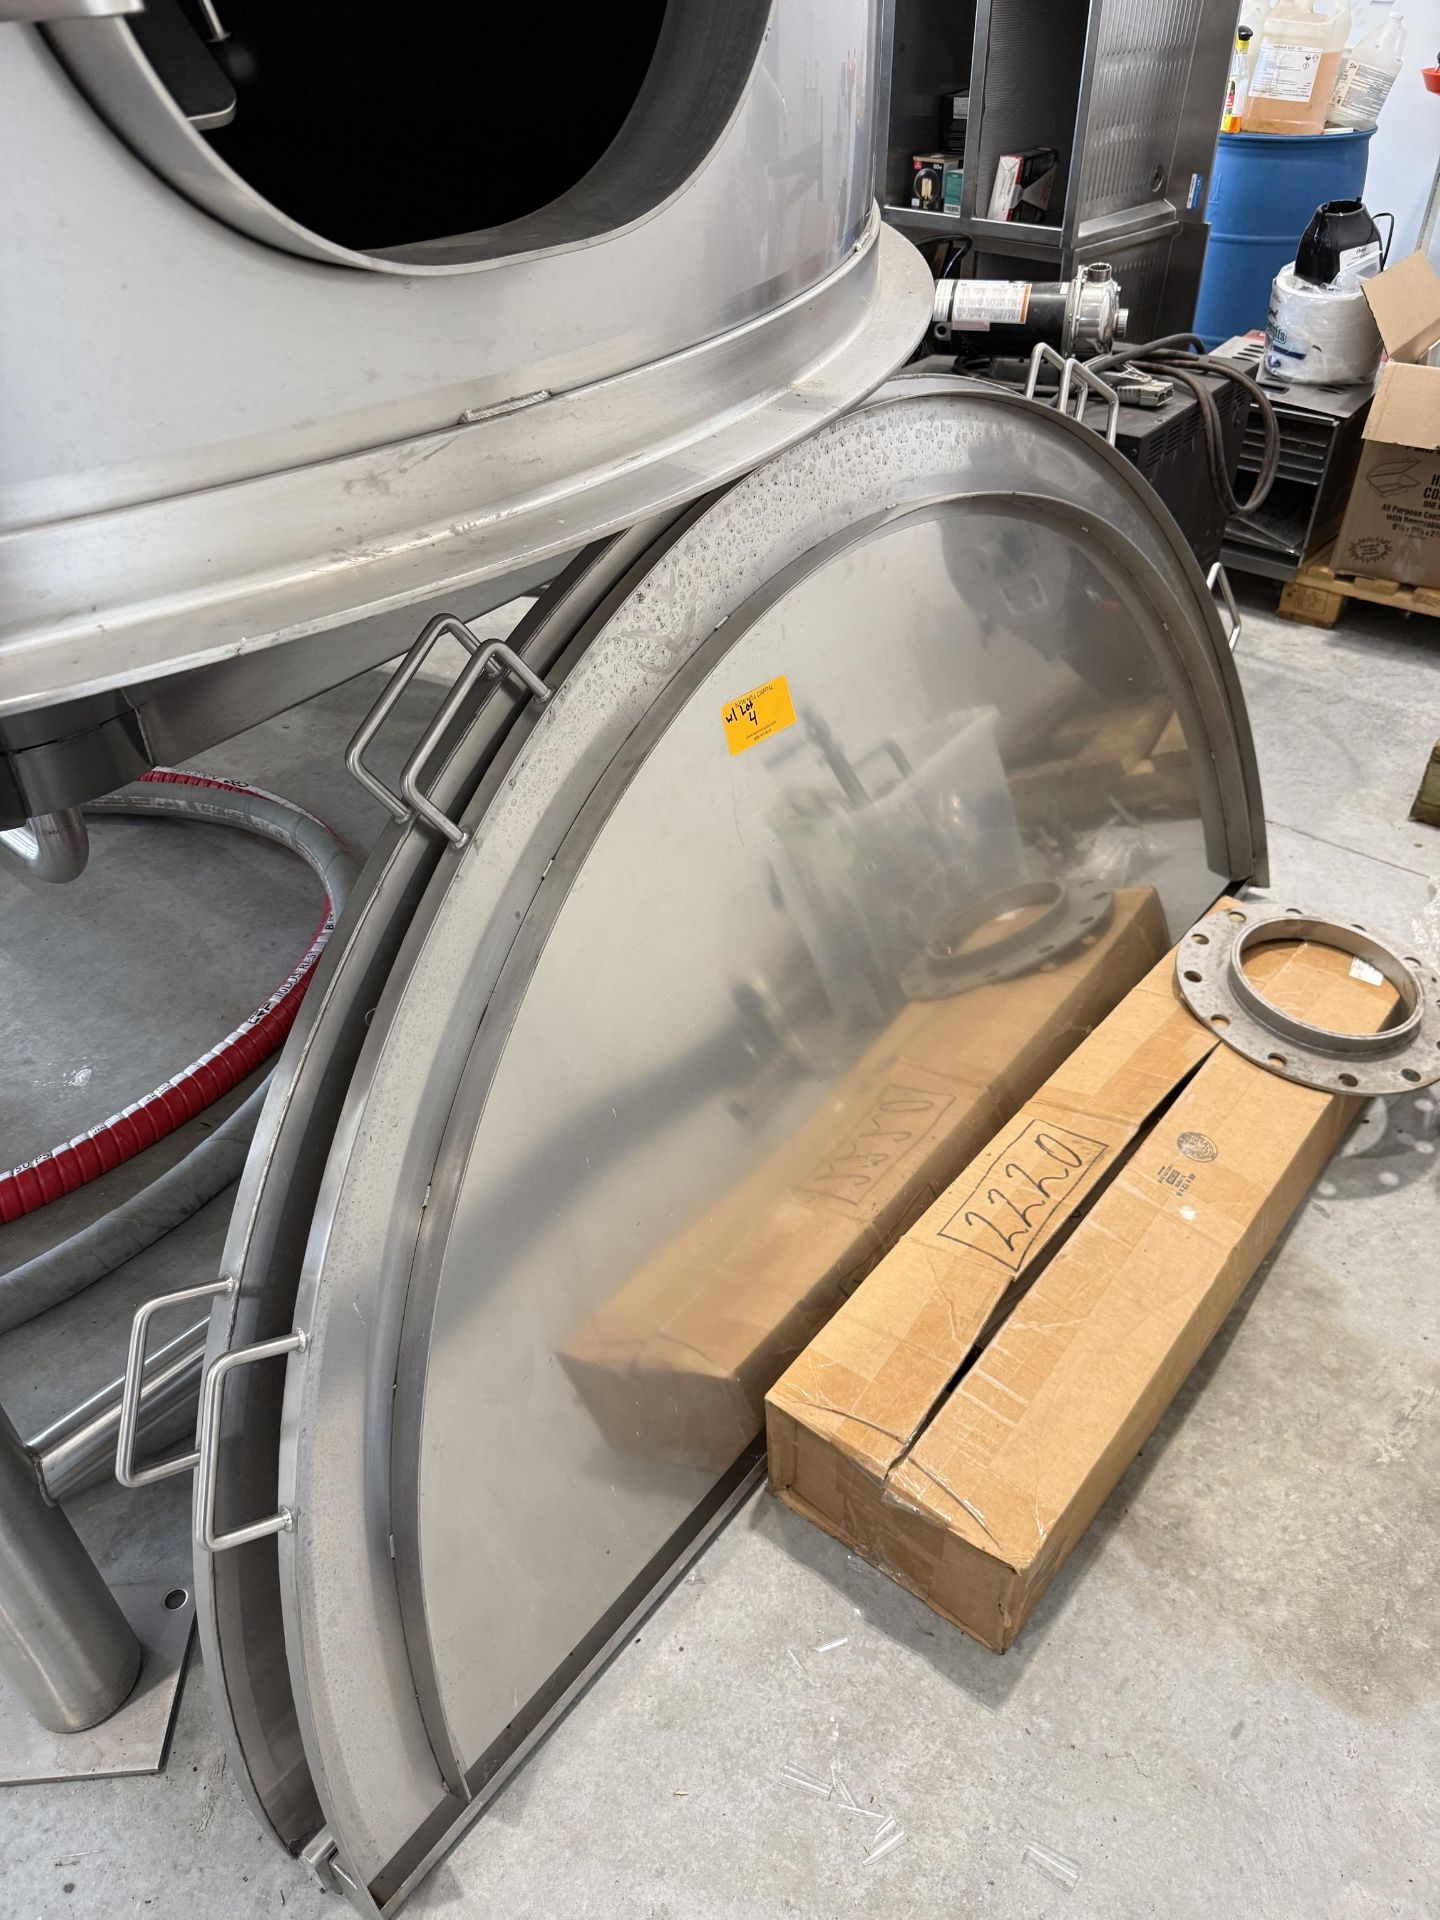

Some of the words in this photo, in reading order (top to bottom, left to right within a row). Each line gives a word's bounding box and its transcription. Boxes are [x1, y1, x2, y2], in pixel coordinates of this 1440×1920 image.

[1423, 487, 1440, 500] CO
[1386, 514, 1402, 522] with
[1392, 505, 1422, 518] Purpose
[740, 700, 753, 716] Lot
[749, 710, 758, 726] 4
[965, 1133, 1082, 1251] 2220
